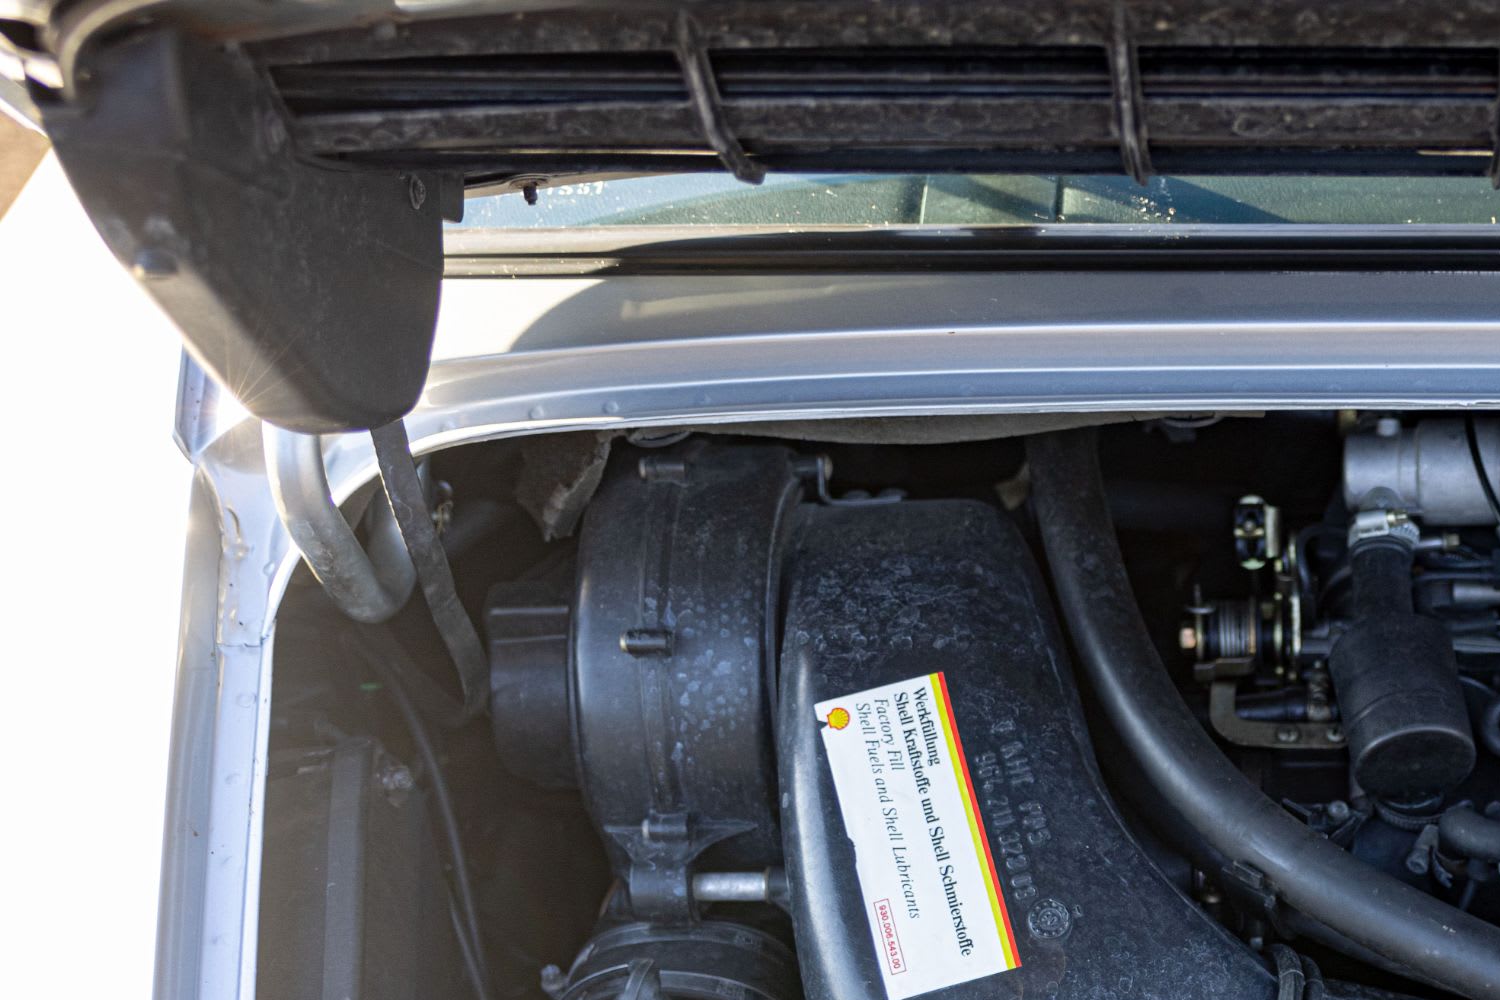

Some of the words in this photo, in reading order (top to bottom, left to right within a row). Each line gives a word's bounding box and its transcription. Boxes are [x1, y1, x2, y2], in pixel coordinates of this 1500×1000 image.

[856, 702, 876, 736] Shell
[894, 692, 915, 726] Shell
[913, 686, 941, 765] Werkfüllung
[874, 698, 895, 746] Factory
[887, 749, 906, 771] Fill
[866, 739, 883, 774] Fuels
[902, 728, 930, 795] Kraftstoffe
[876, 777, 892, 804] and
[882, 807, 904, 841] Shell
[922, 798, 941, 823] und
[929, 826, 951, 863] Shell
[893, 845, 920, 920] Lubricants
[939, 865, 974, 957] Schmierstoffe
